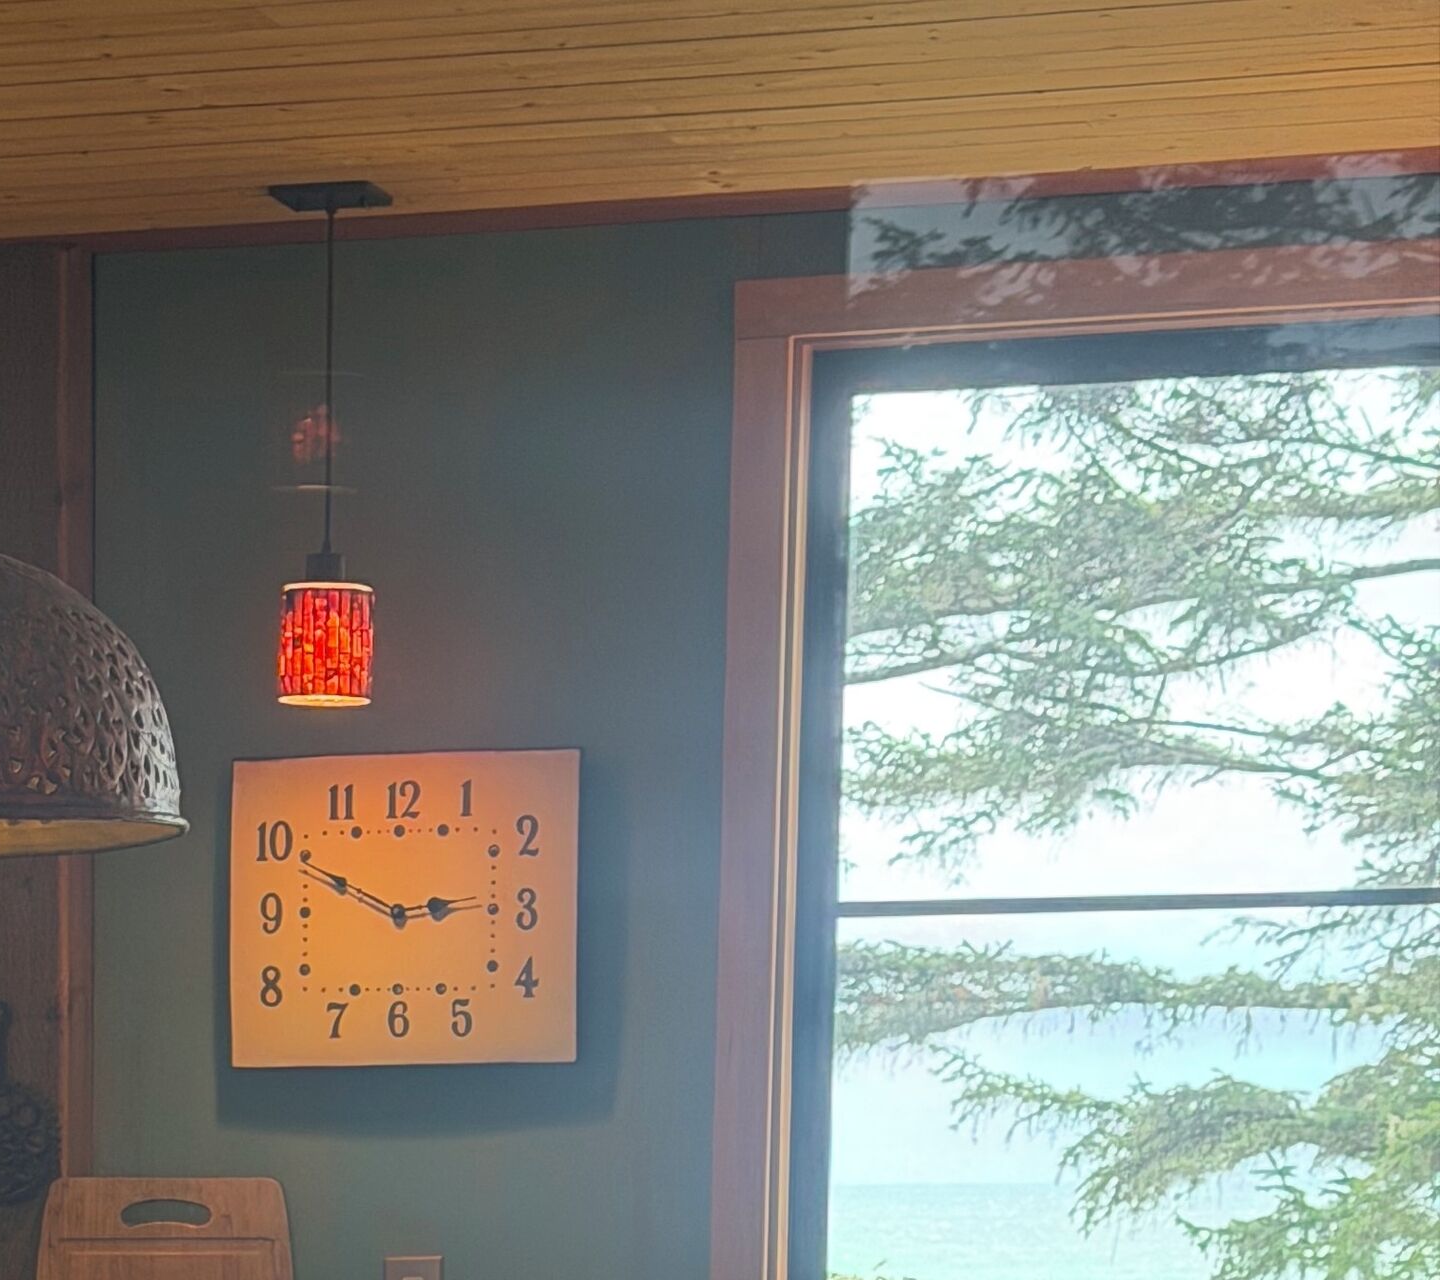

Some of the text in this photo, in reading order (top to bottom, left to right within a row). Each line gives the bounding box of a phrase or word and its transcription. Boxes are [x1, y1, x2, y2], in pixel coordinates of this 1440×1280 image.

[328, 783, 355, 820] 11
[385, 780, 421, 819] 12
[460, 779, 473, 817] 1
[255, 820, 294, 862] 10
[515, 814, 540, 857] 2
[260, 892, 283, 934] 9
[515, 887, 538, 930] 3
[260, 965, 283, 1008] 8
[514, 956, 540, 998] 4
[326, 1002, 349, 1039] 7
[387, 1000, 410, 1038] 6
[450, 998, 473, 1038] 5
